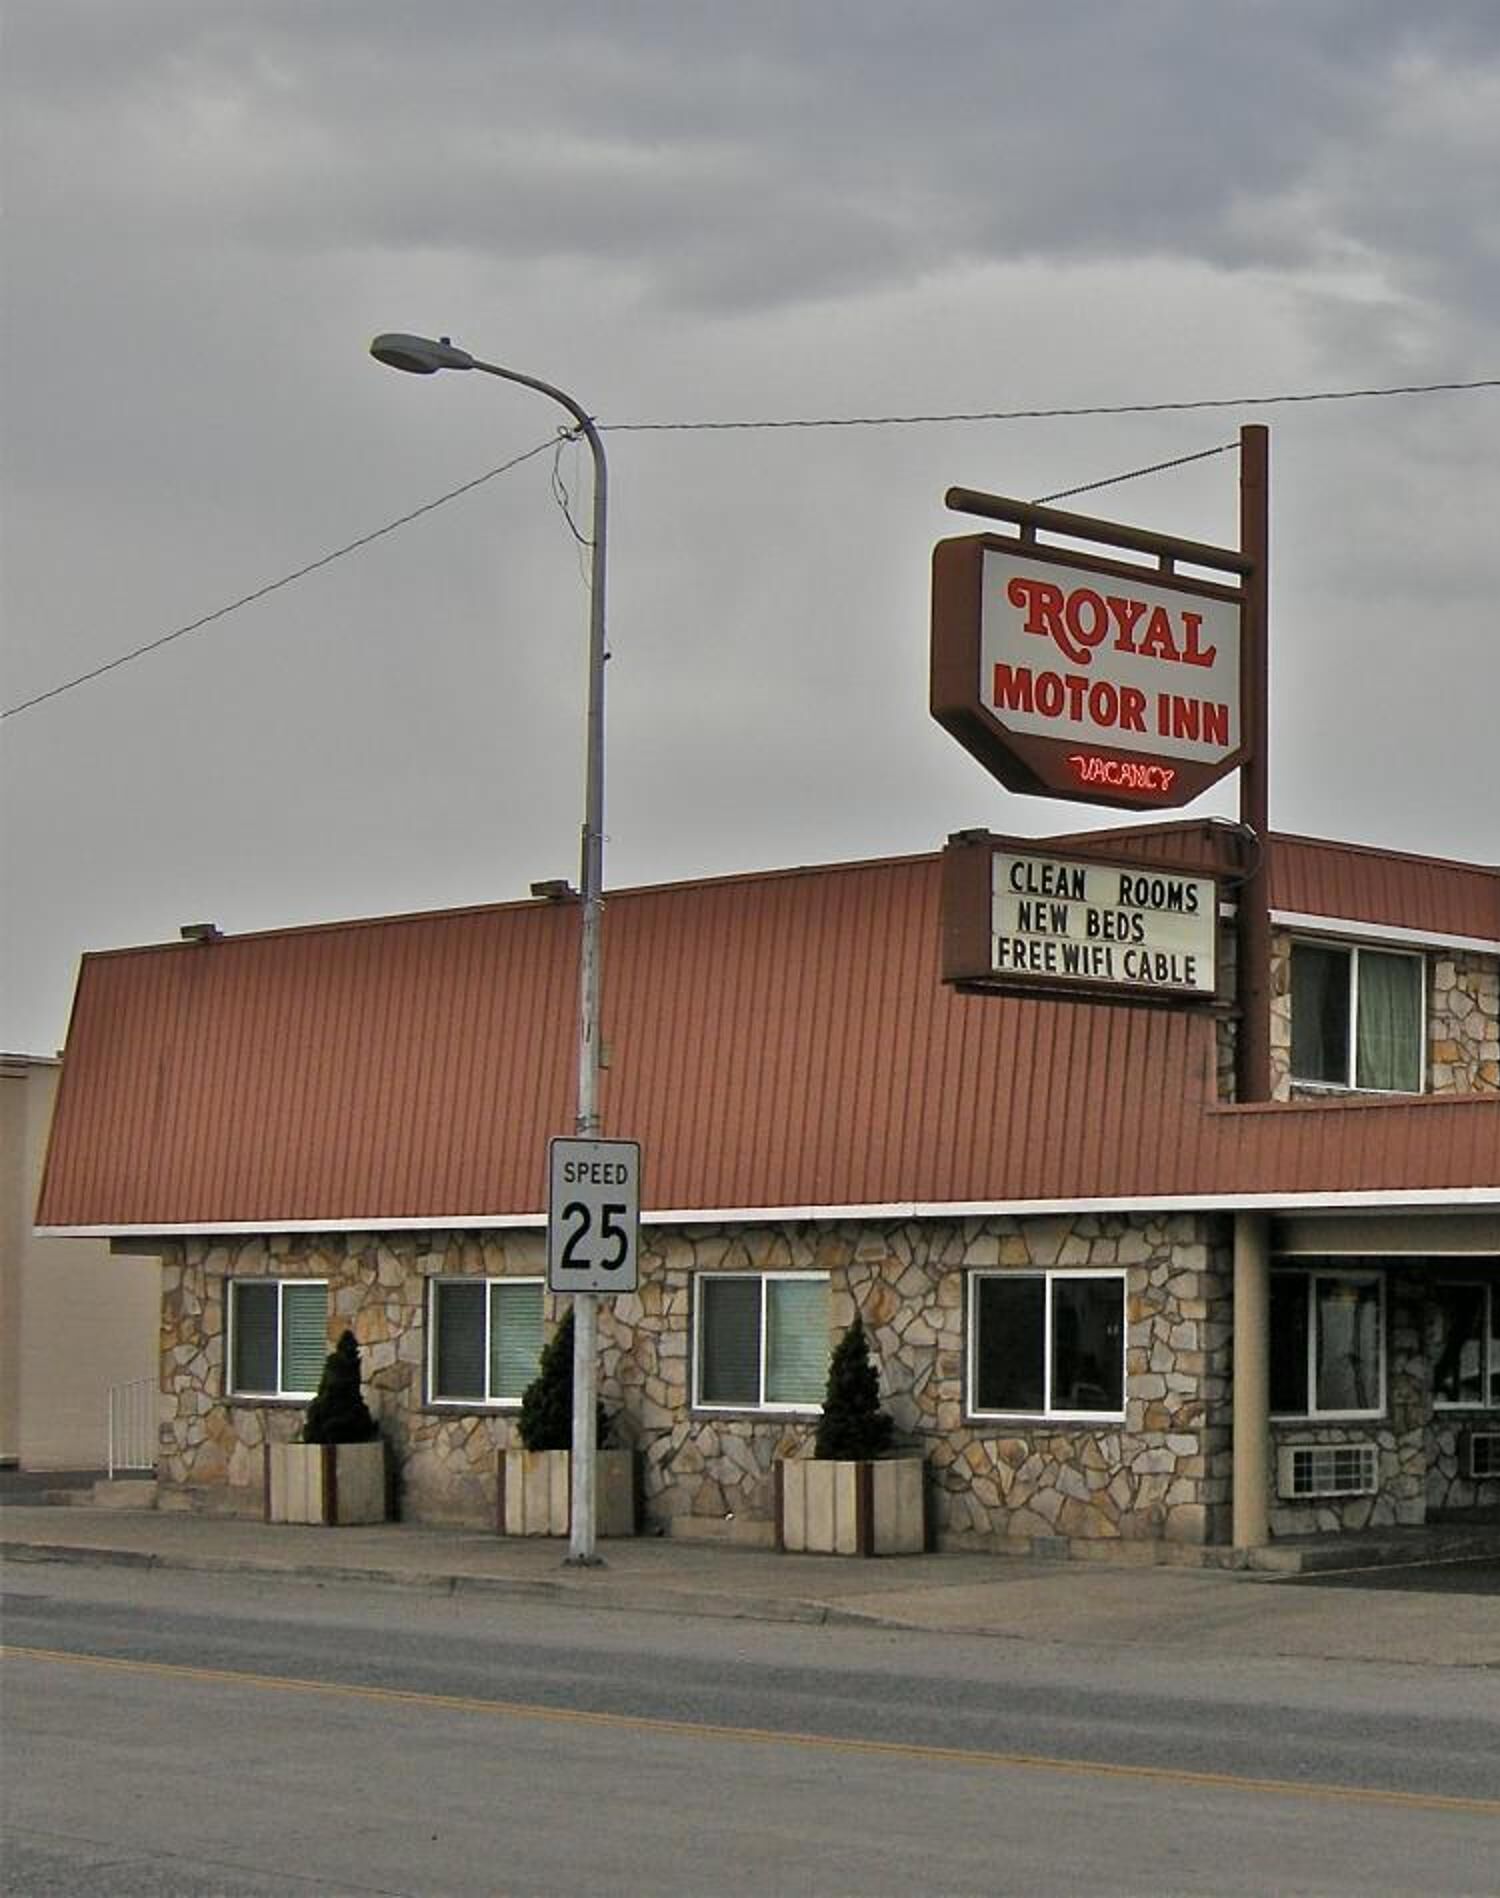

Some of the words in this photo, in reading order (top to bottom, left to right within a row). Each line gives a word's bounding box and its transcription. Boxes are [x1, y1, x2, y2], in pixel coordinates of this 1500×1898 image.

[1007, 577, 1217, 668] ROYAL
[993, 663, 1147, 732] MOTOR
[1157, 693, 1229, 746] INN
[1069, 755, 1175, 791] VACANCY
[1009, 861, 1086, 900] CLEAN
[1119, 874, 1198, 912] ROOMS
[1017, 901, 1068, 933] NEW
[1086, 909, 1144, 942] BEDS
[1123, 949, 1197, 985] CABLE
[564, 1162, 628, 1185] SPEED
[561, 1201, 628, 1271] 25
